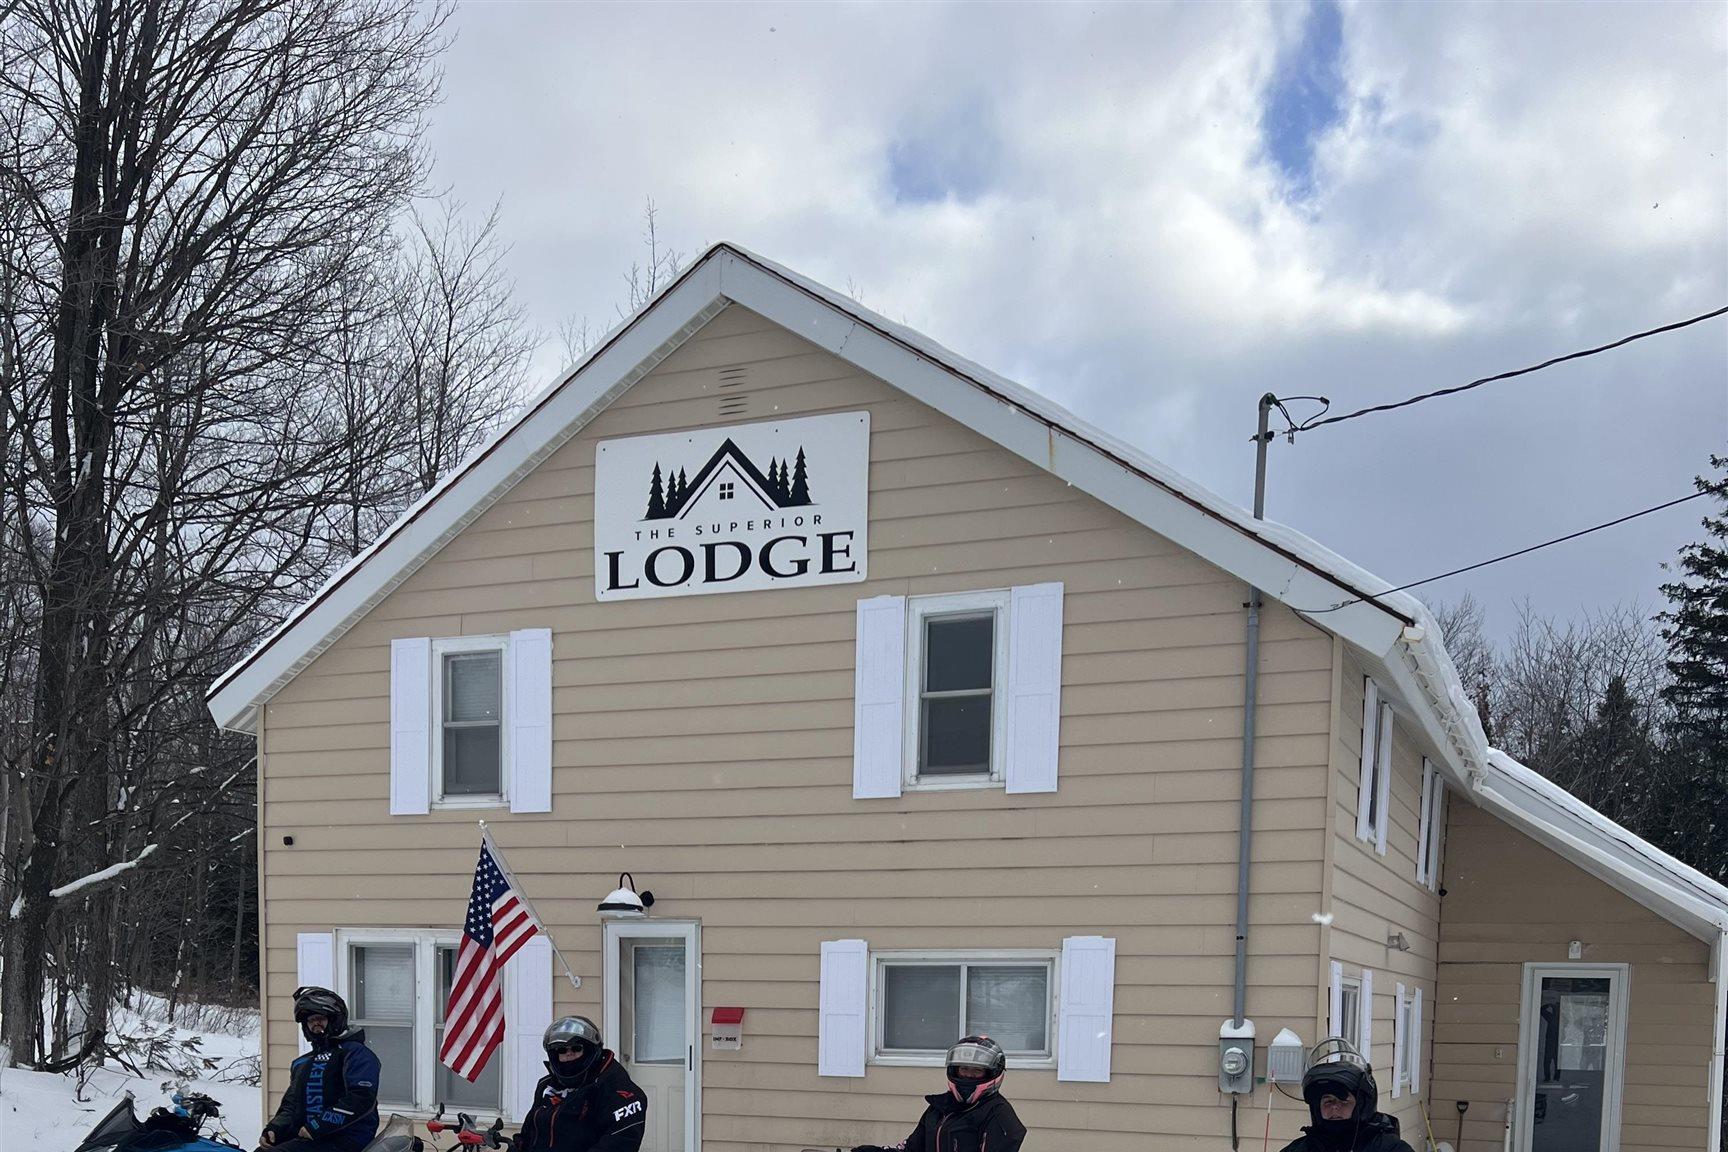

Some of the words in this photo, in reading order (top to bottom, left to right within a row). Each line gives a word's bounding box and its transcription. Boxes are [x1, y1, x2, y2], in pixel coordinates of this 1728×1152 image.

[635, 528, 675, 541] THE
[695, 514, 823, 536] SUPERIOR
[603, 531, 856, 591] LODGE
[612, 1101, 642, 1121] FXR
